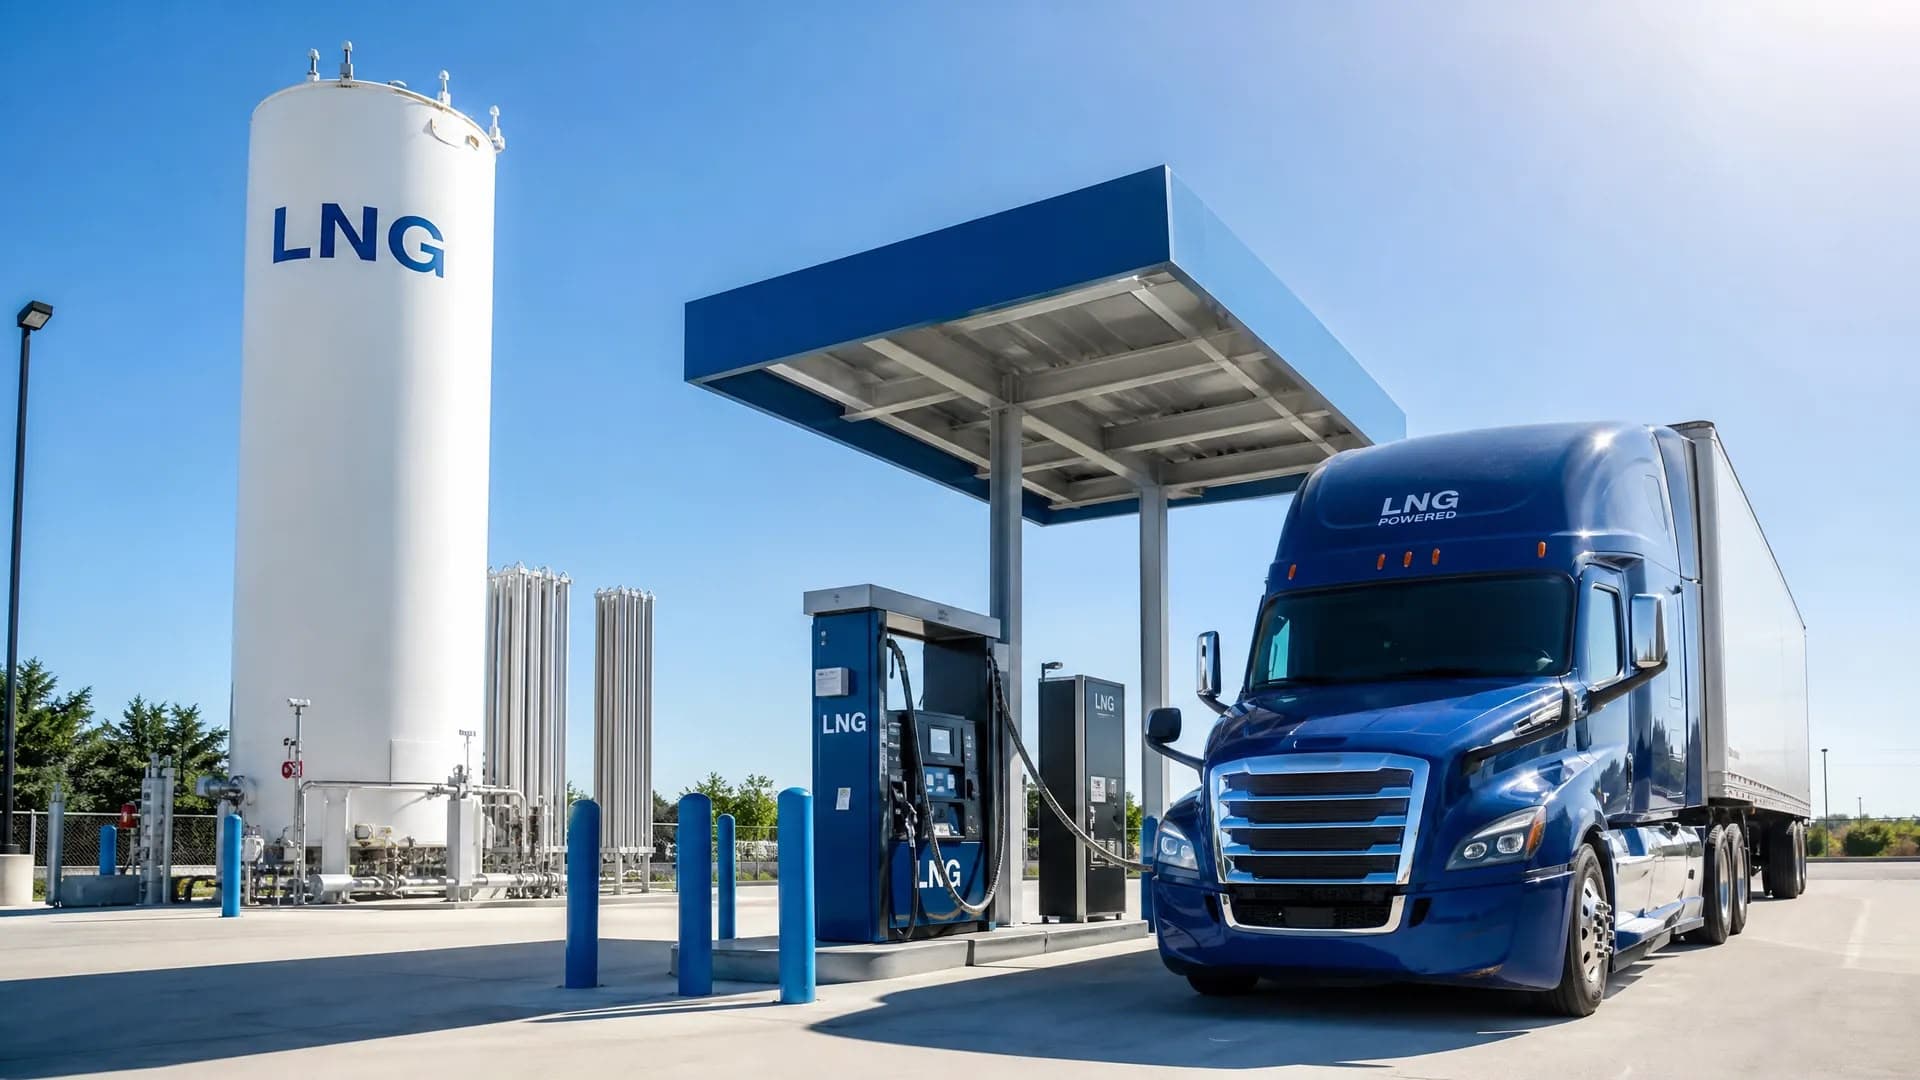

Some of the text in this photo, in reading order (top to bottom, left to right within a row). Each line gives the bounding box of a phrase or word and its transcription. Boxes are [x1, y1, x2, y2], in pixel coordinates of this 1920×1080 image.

[273, 203, 444, 278] LNG
[1381, 490, 1459, 516] LNG
[1378, 511, 1457, 526] POWERED
[1095, 692, 1115, 711] LNG
[823, 712, 866, 734] LNG
[915, 859, 961, 888] LNG
